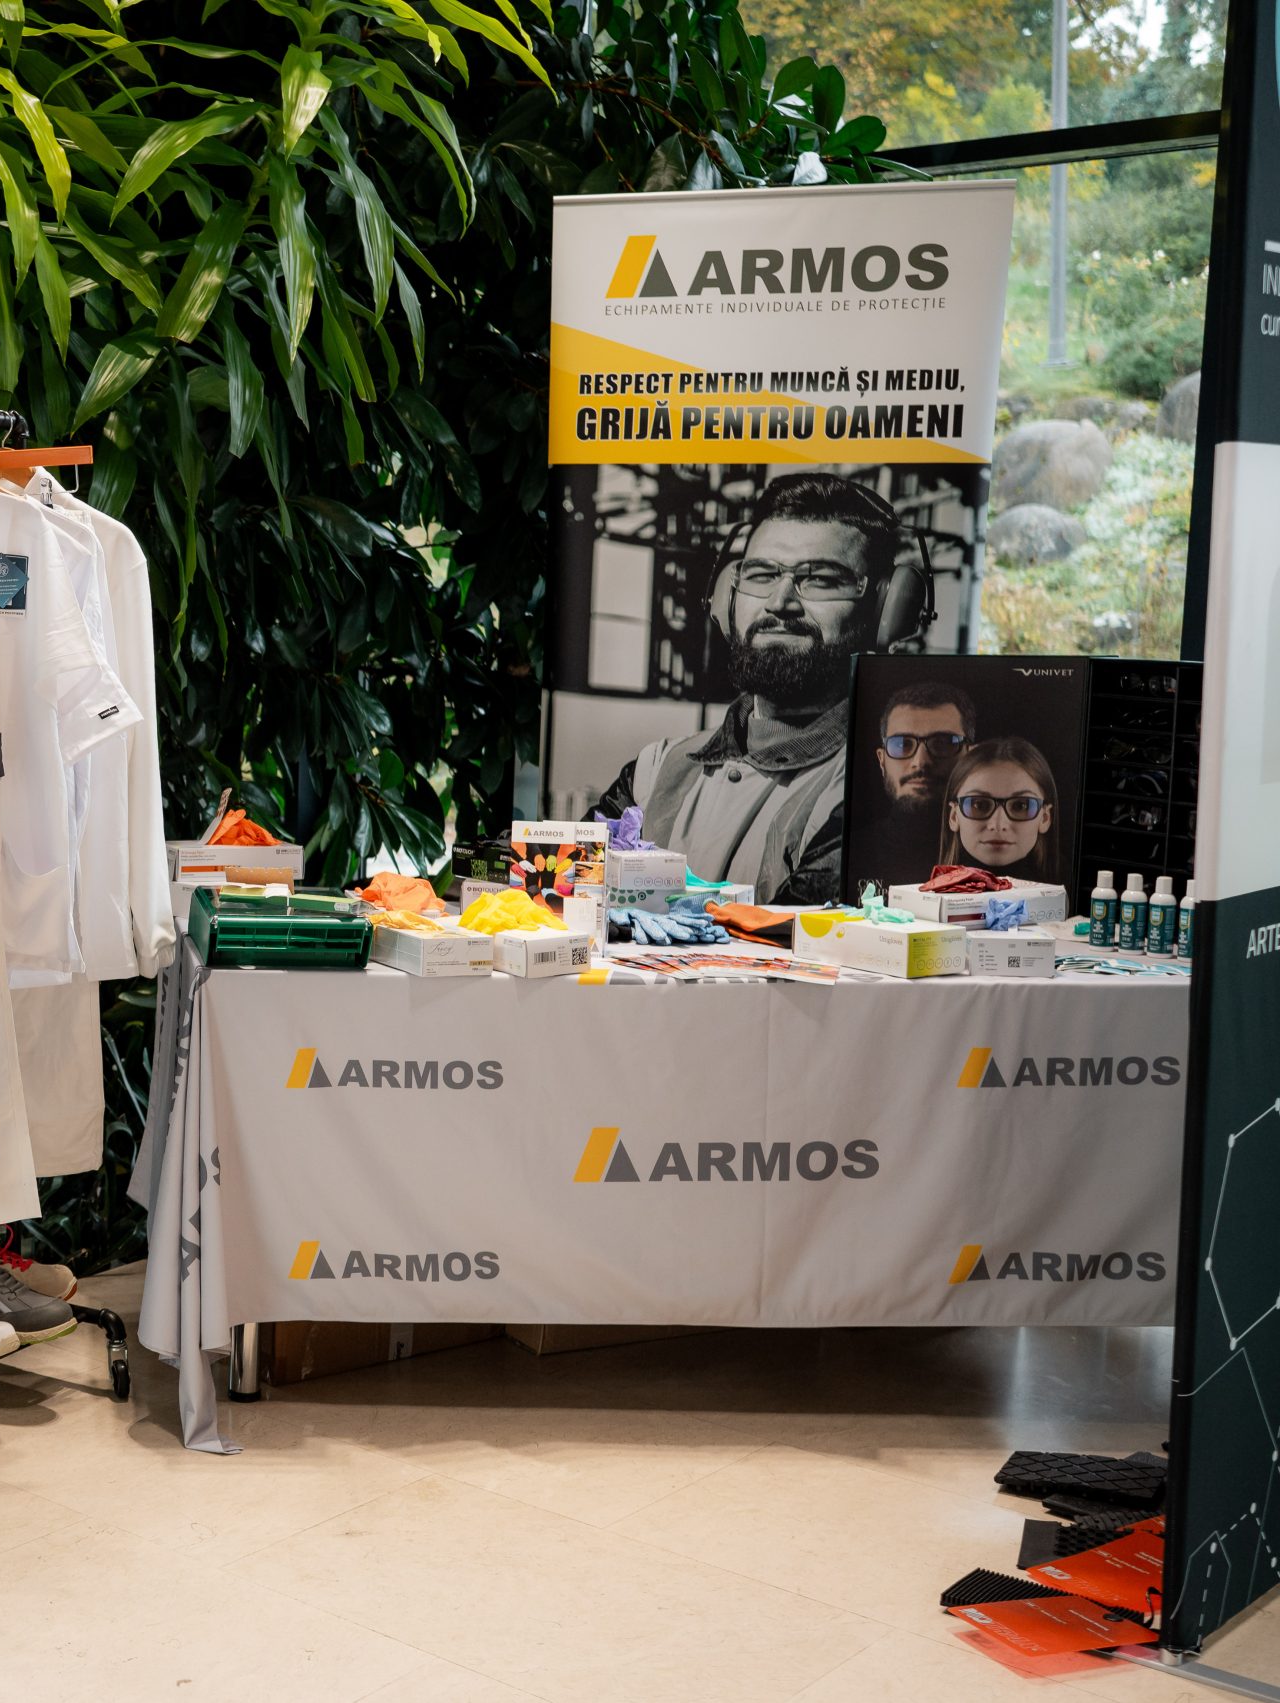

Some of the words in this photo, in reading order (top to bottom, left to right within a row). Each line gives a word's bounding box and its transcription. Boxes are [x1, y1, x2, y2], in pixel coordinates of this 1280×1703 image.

[687, 243, 950, 298] ARMOS
[604, 303, 713, 316] ECHIPAMENTE
[720, 300, 823, 314] INDIVIDUALE
[831, 299, 850, 312] DE
[578, 372, 674, 396] RESPECT
[679, 371, 764, 394] PENTRU
[770, 366, 852, 393] MUNCĂ
[856, 370, 879, 398] ȘI
[885, 368, 966, 393] MEDIU,
[576, 401, 672, 441] GRIJĂ
[681, 406, 816, 440] PENTRU
[824, 404, 965, 440] OAMENI
[1033, 669, 1074, 677] UNIVET
[533, 830, 564, 838] ARMOS
[337, 1059, 504, 1090] ARMOS
[1012, 1055, 1182, 1087] ARMOS
[648, 1138, 880, 1181] ARMOS
[341, 1251, 500, 1283] ARMOS
[996, 1251, 1167, 1283] ARMOS
